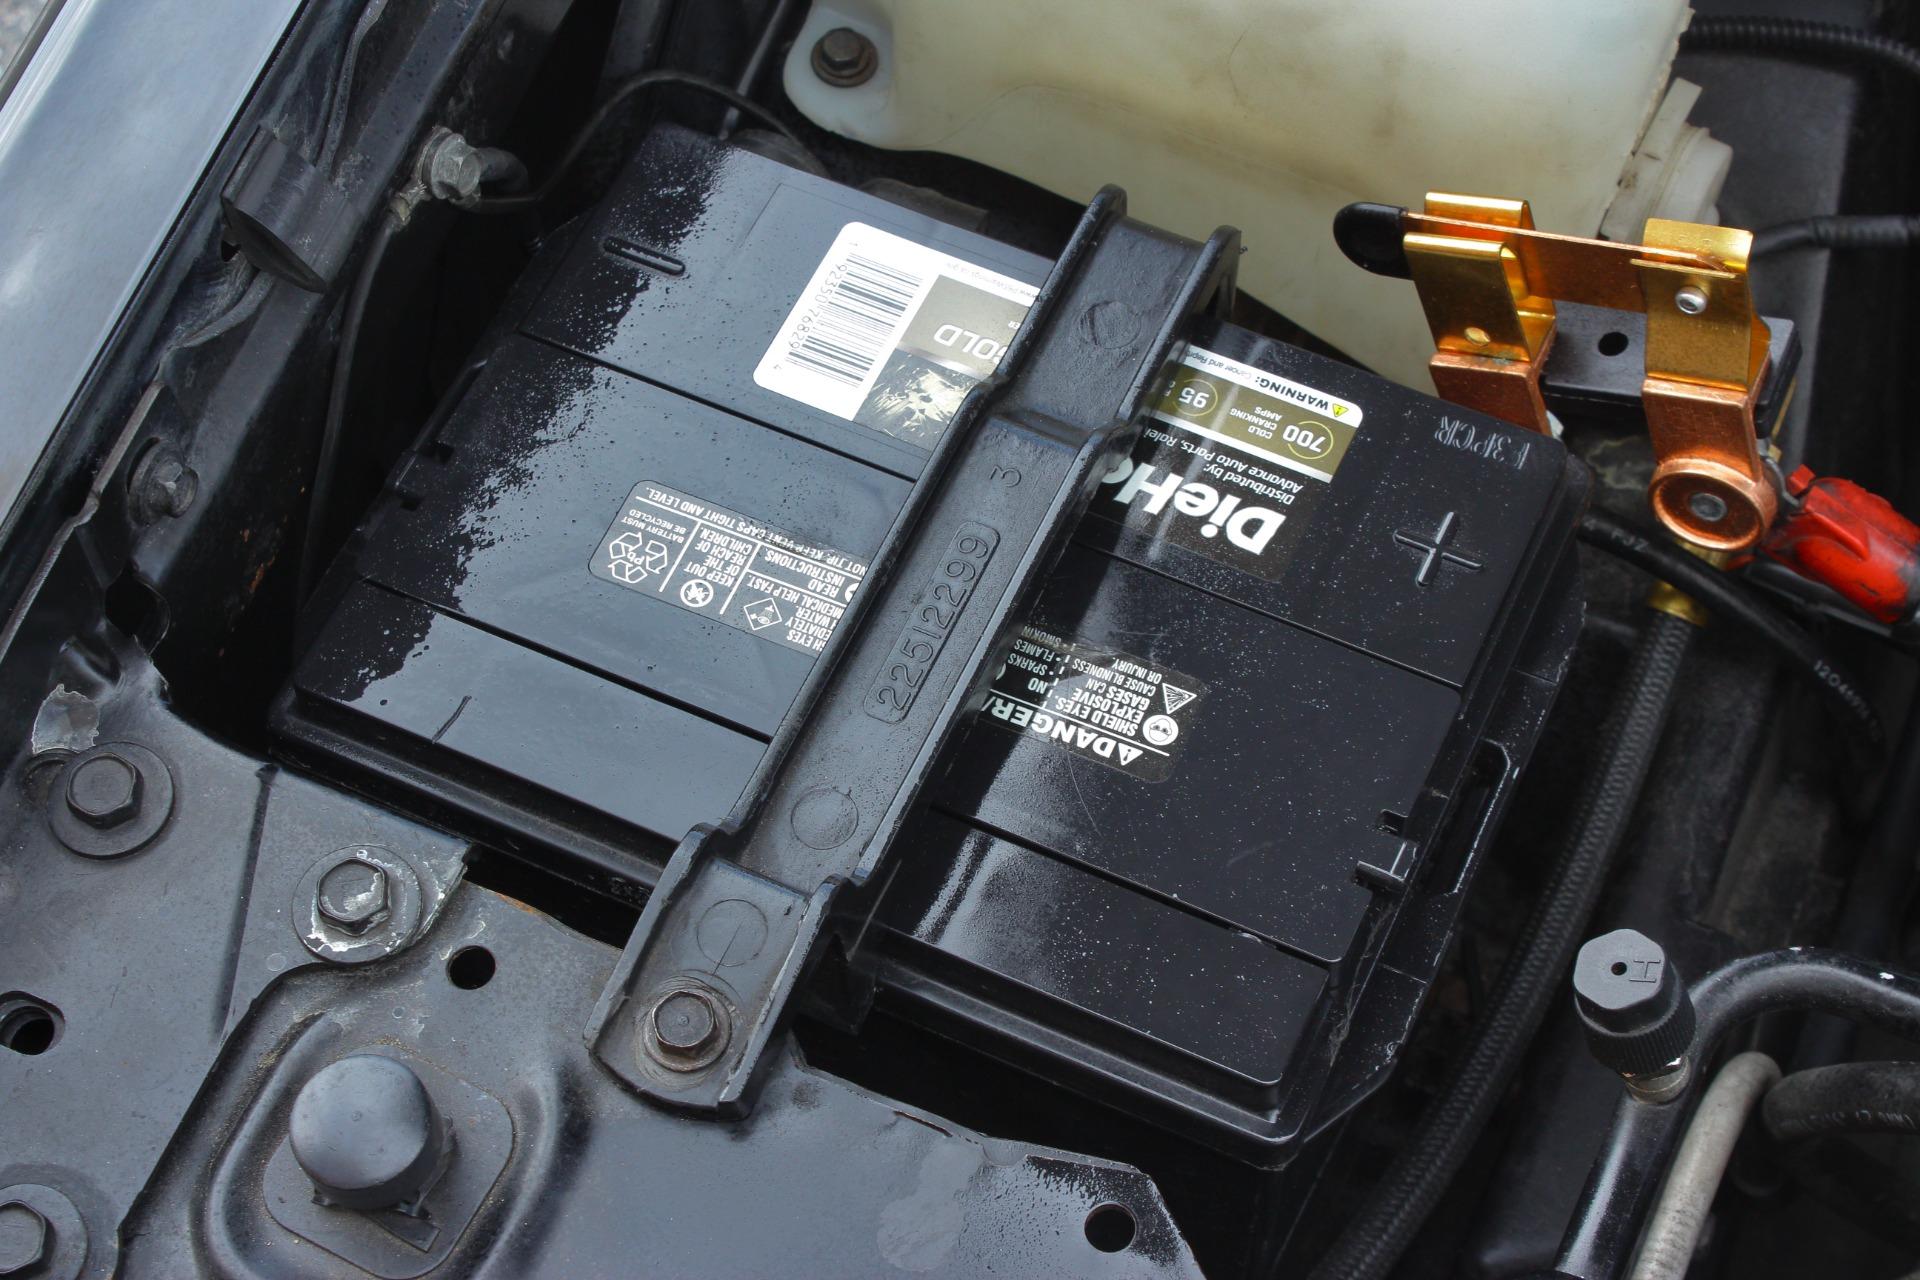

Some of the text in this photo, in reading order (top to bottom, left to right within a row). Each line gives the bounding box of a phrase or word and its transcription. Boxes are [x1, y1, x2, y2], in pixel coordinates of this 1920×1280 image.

[815, 265, 845, 303] 92350
[789, 309, 819, 348] 76829
[1208, 359, 1224, 368] and
[1179, 388, 1209, 409] 95
[1256, 377, 1328, 410] WARNING:
[1230, 408, 1277, 430] CRANKING
[1255, 407, 1282, 421] AMPS
[1248, 426, 1272, 439] COLD
[1283, 425, 1325, 452] 700
[1181, 440, 1215, 461] Parts,
[1216, 455, 1248, 472] Auto
[990, 464, 1023, 489] 3
[1203, 460, 1295, 504] Distributed by:
[1248, 467, 1303, 493] Advance
[643, 488, 680, 510] LEVEL.
[680, 502, 704, 519] AND
[622, 515, 684, 543] BATTERY MUST
[629, 509, 686, 534] BE RECYCLED
[701, 510, 735, 529] TIGHT
[737, 518, 766, 539] CAPS
[695, 537, 746, 565] REACH OF
[700, 527, 752, 555] CHILDREN.
[627, 549, 648, 567] Pb
[703, 554, 740, 578] OF THE
[765, 548, 845, 587] INSTRUCTIONS.
[684, 562, 735, 587] KEEP OUT
[747, 572, 844, 621] MEDICAL HELP FAST.
[808, 576, 841, 598] READ
[796, 605, 833, 629] WATER.
[787, 628, 815, 647] EYES
[1015, 639, 1055, 661] FLAMES
[1008, 653, 1047, 675] SPARKS
[1111, 658, 1162, 684] OR INJURY.
[1028, 678, 1050, 694] NO
[1072, 659, 1156, 696] CAUSE BLINDNESS
[1070, 686, 1144, 724] EXPLOSIVE
[1085, 678, 1150, 710] GASES CAN
[1055, 695, 1139, 736] SHIELD EYES.
